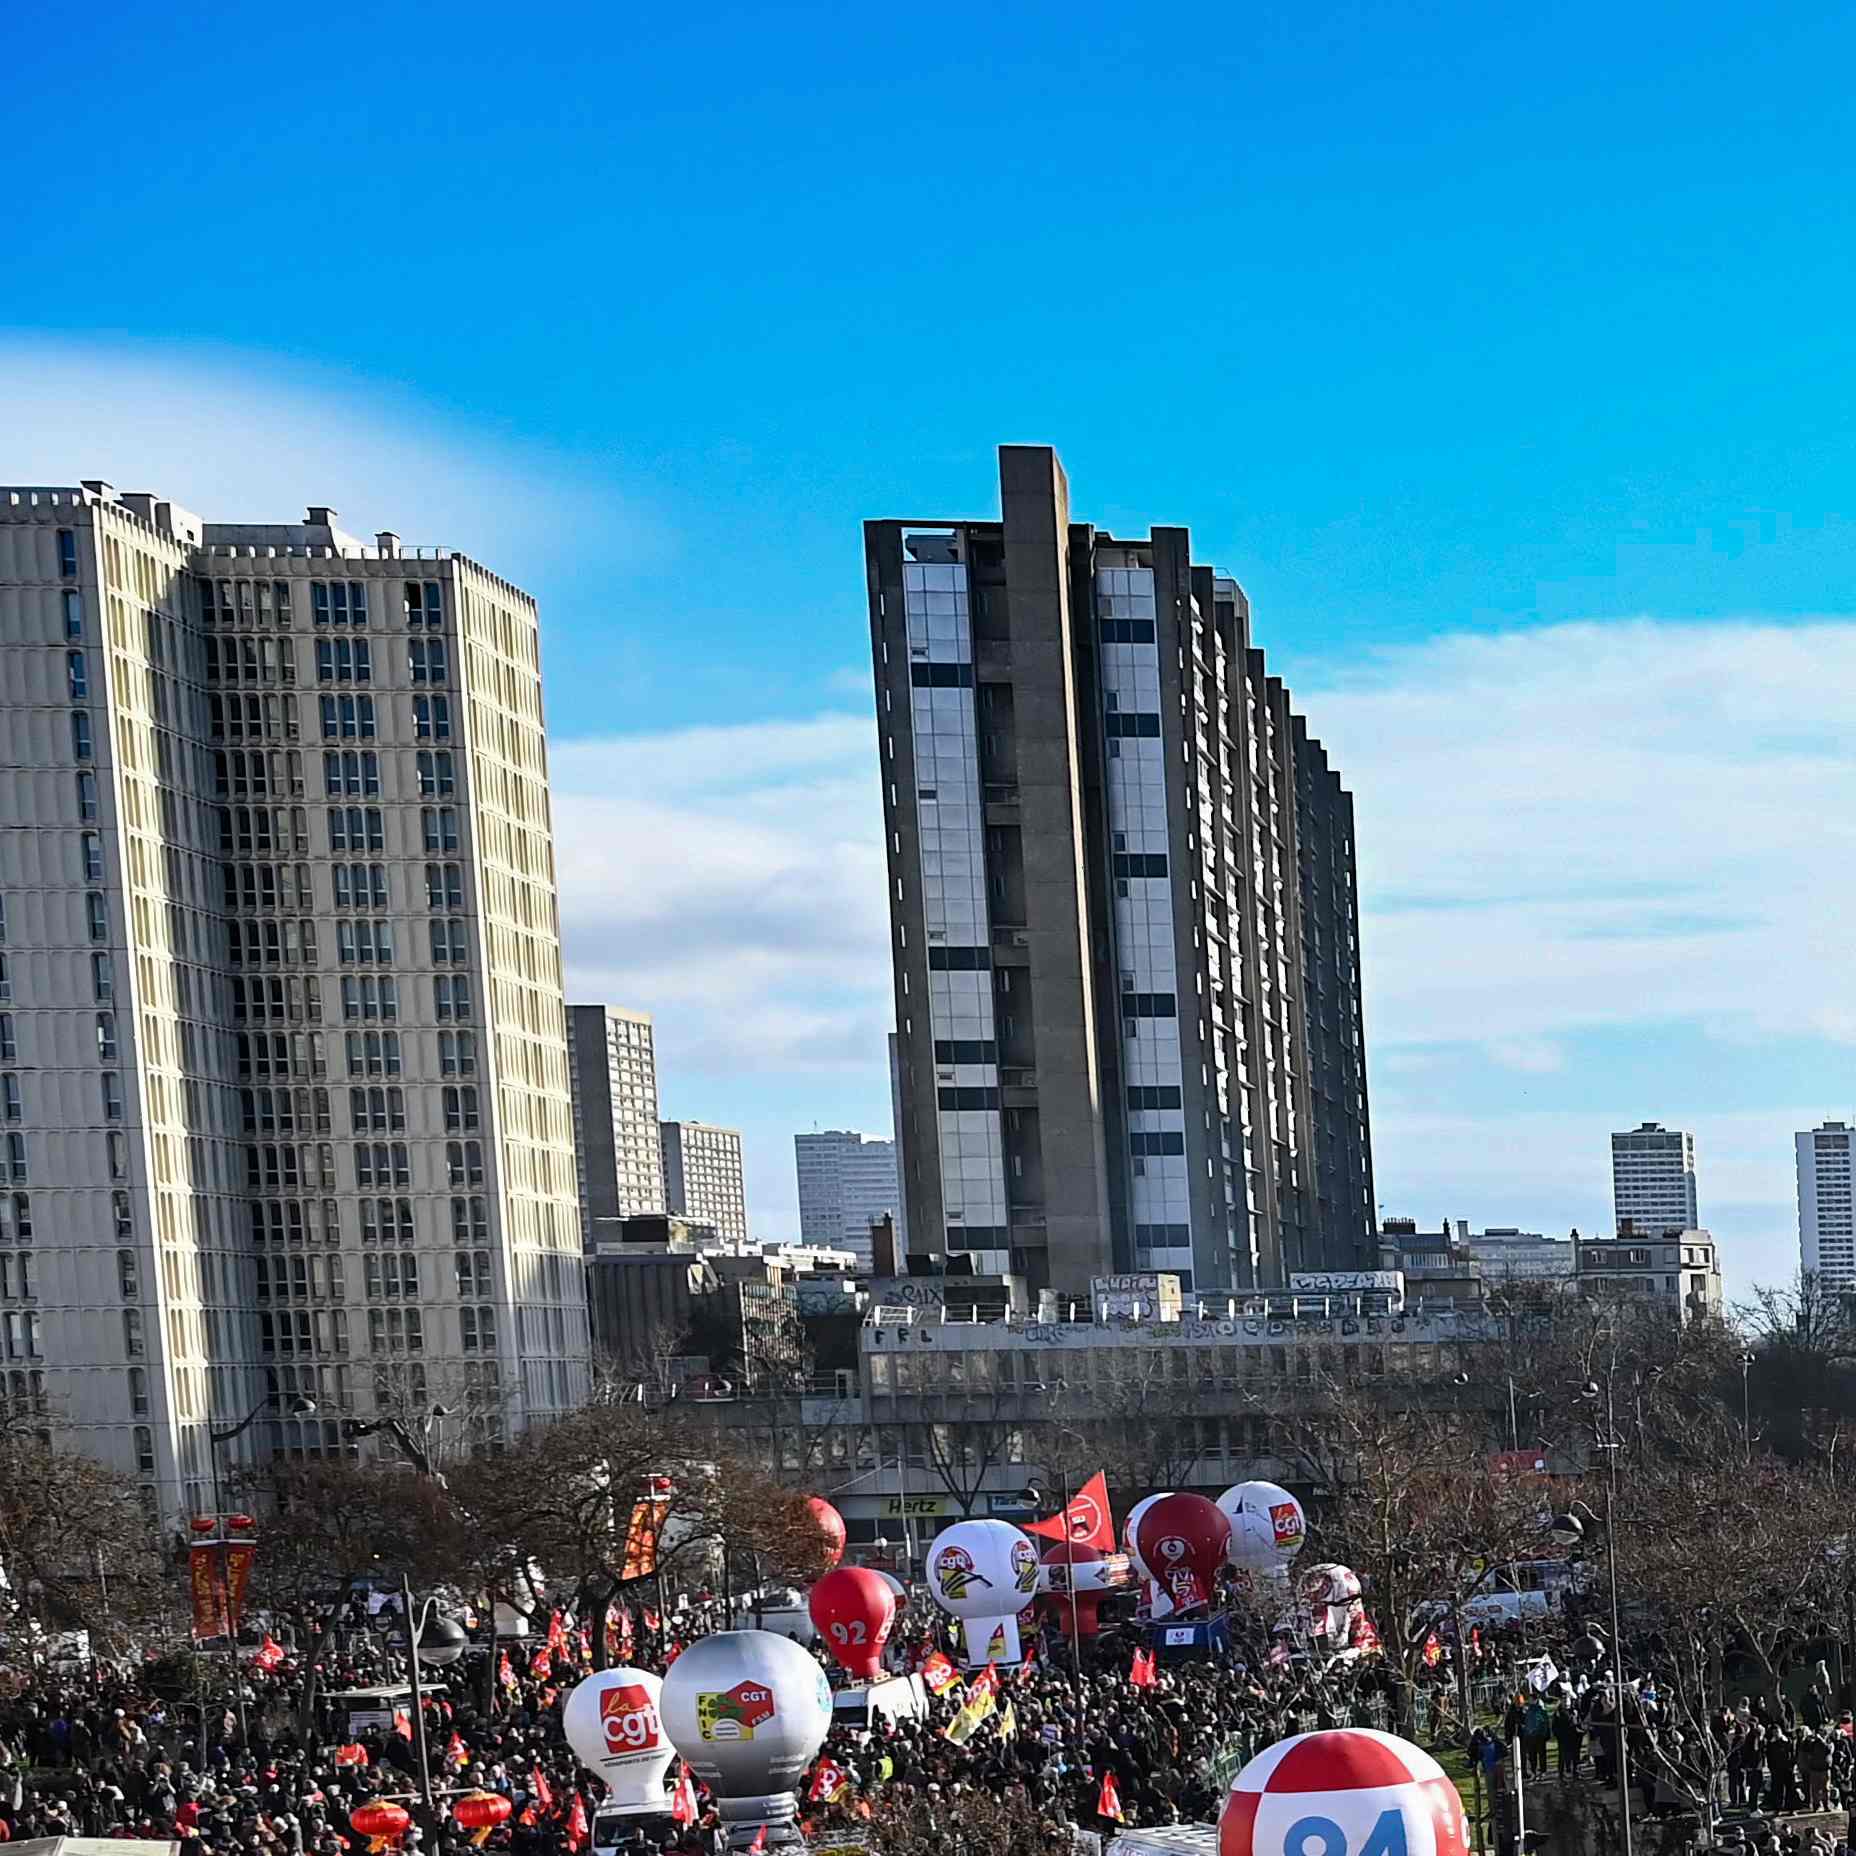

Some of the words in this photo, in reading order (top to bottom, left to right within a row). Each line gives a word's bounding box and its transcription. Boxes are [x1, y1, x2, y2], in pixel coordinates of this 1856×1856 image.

[888, 1498, 937, 1514] Hertz
[830, 1619, 867, 1645] 92
[740, 1690, 768, 1702] CGT
[603, 1704, 660, 1746] cgt
